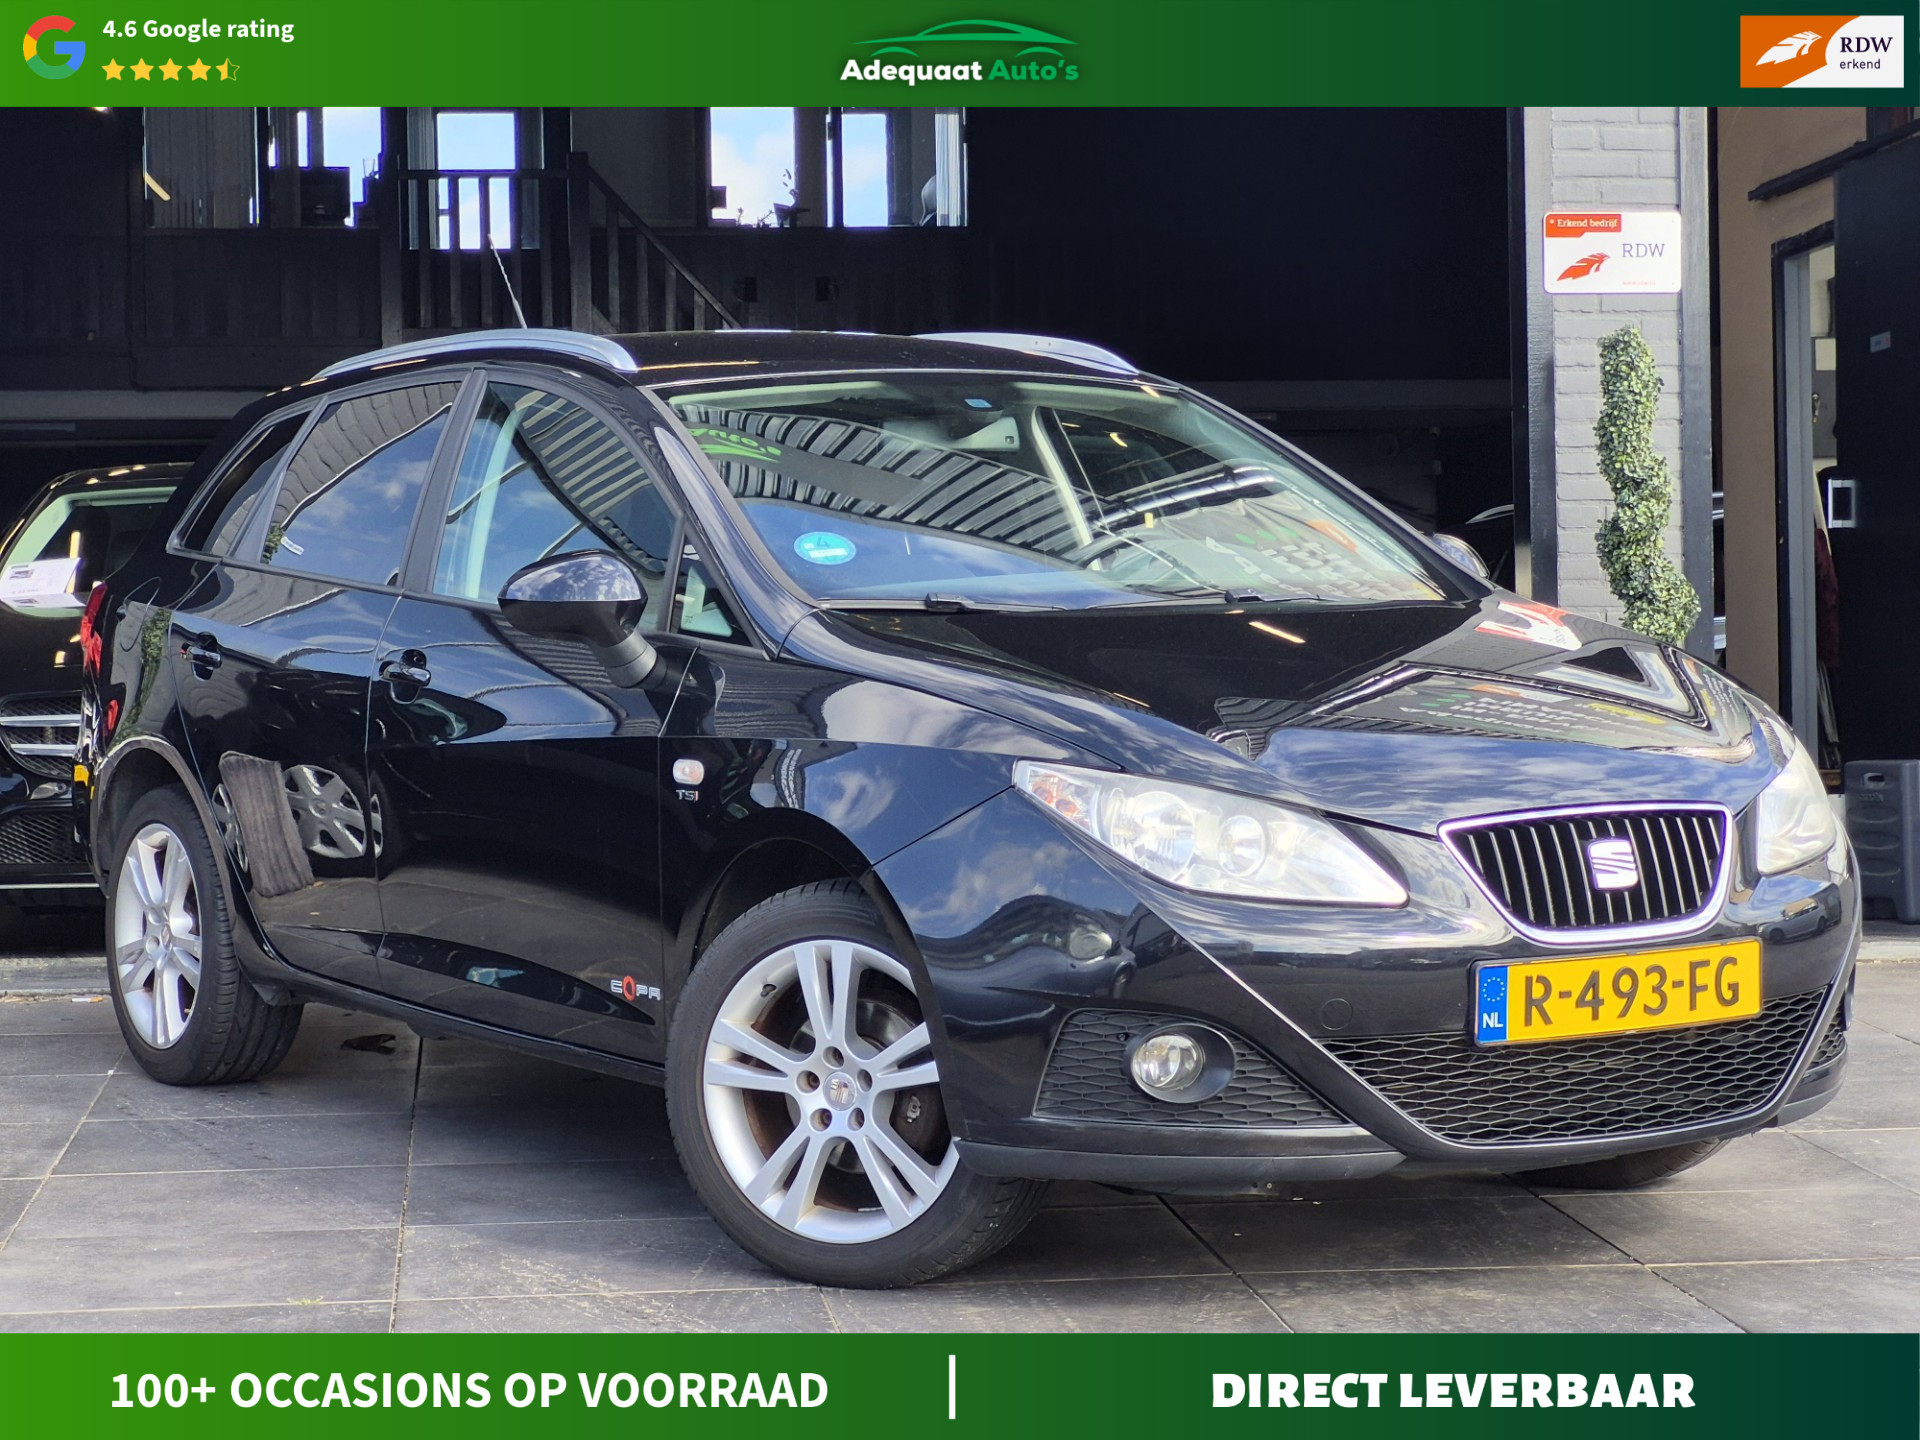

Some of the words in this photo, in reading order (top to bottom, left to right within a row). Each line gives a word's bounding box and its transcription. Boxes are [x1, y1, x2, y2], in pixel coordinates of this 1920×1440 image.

[1557, 218, 1588, 228] Erkend
[1590, 218, 1618, 229] bedrijf
[1622, 243, 1665, 258] RDW
[1523, 955, 1740, 1028] R-493-FG
[1482, 1011, 1504, 1029] NL
